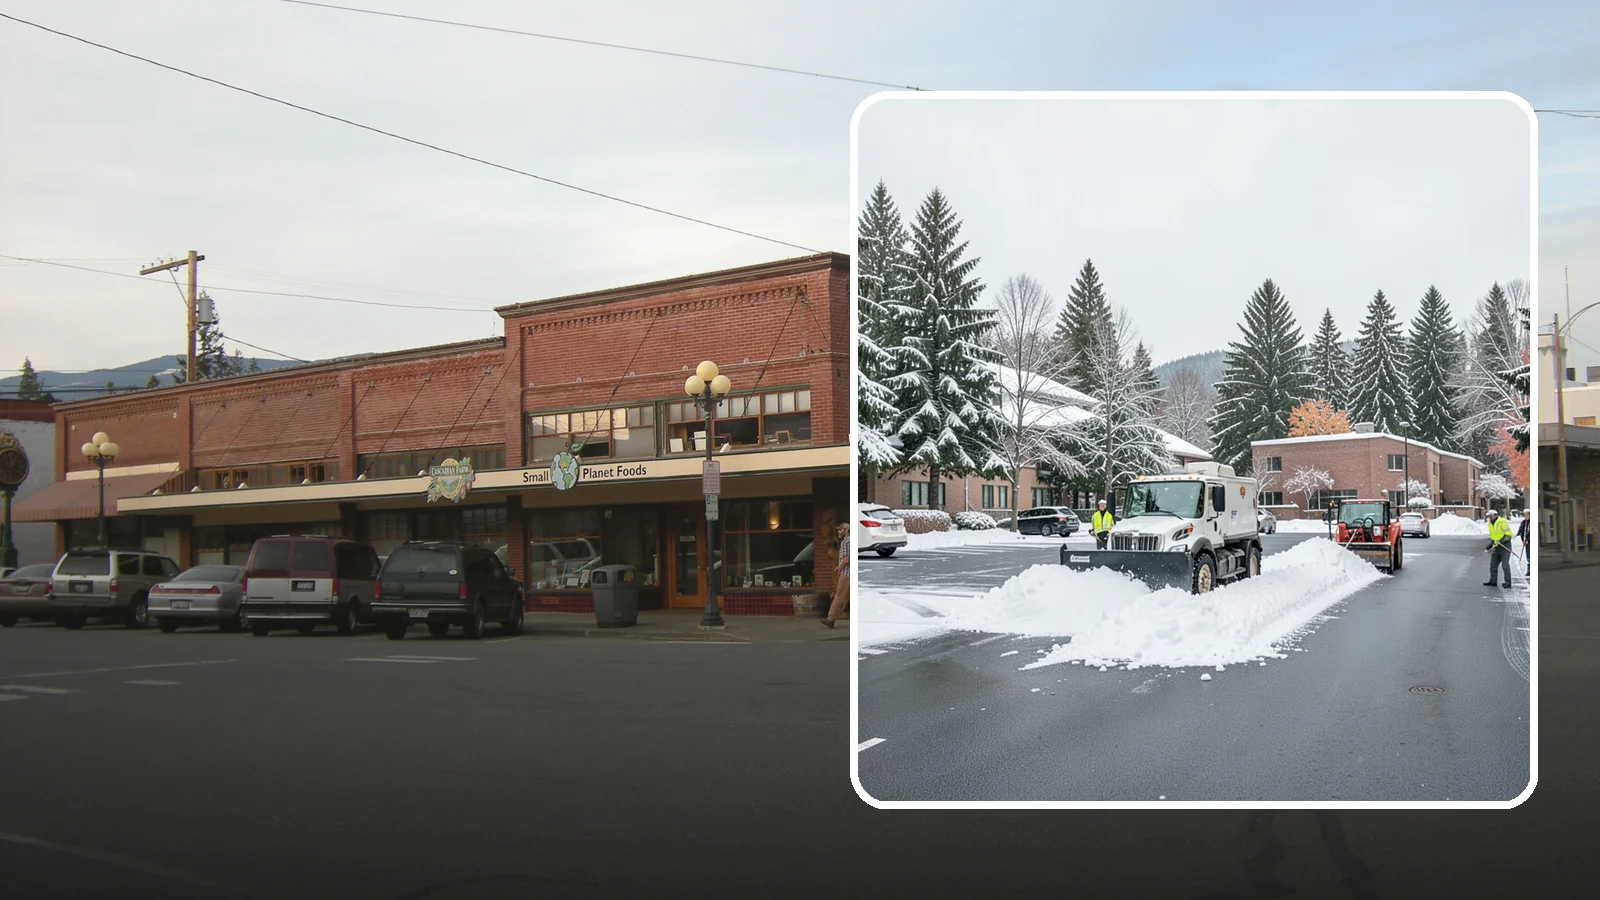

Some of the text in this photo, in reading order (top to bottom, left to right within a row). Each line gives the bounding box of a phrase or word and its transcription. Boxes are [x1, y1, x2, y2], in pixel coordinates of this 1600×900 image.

[523, 464, 647, 483] Small Planet Foods
